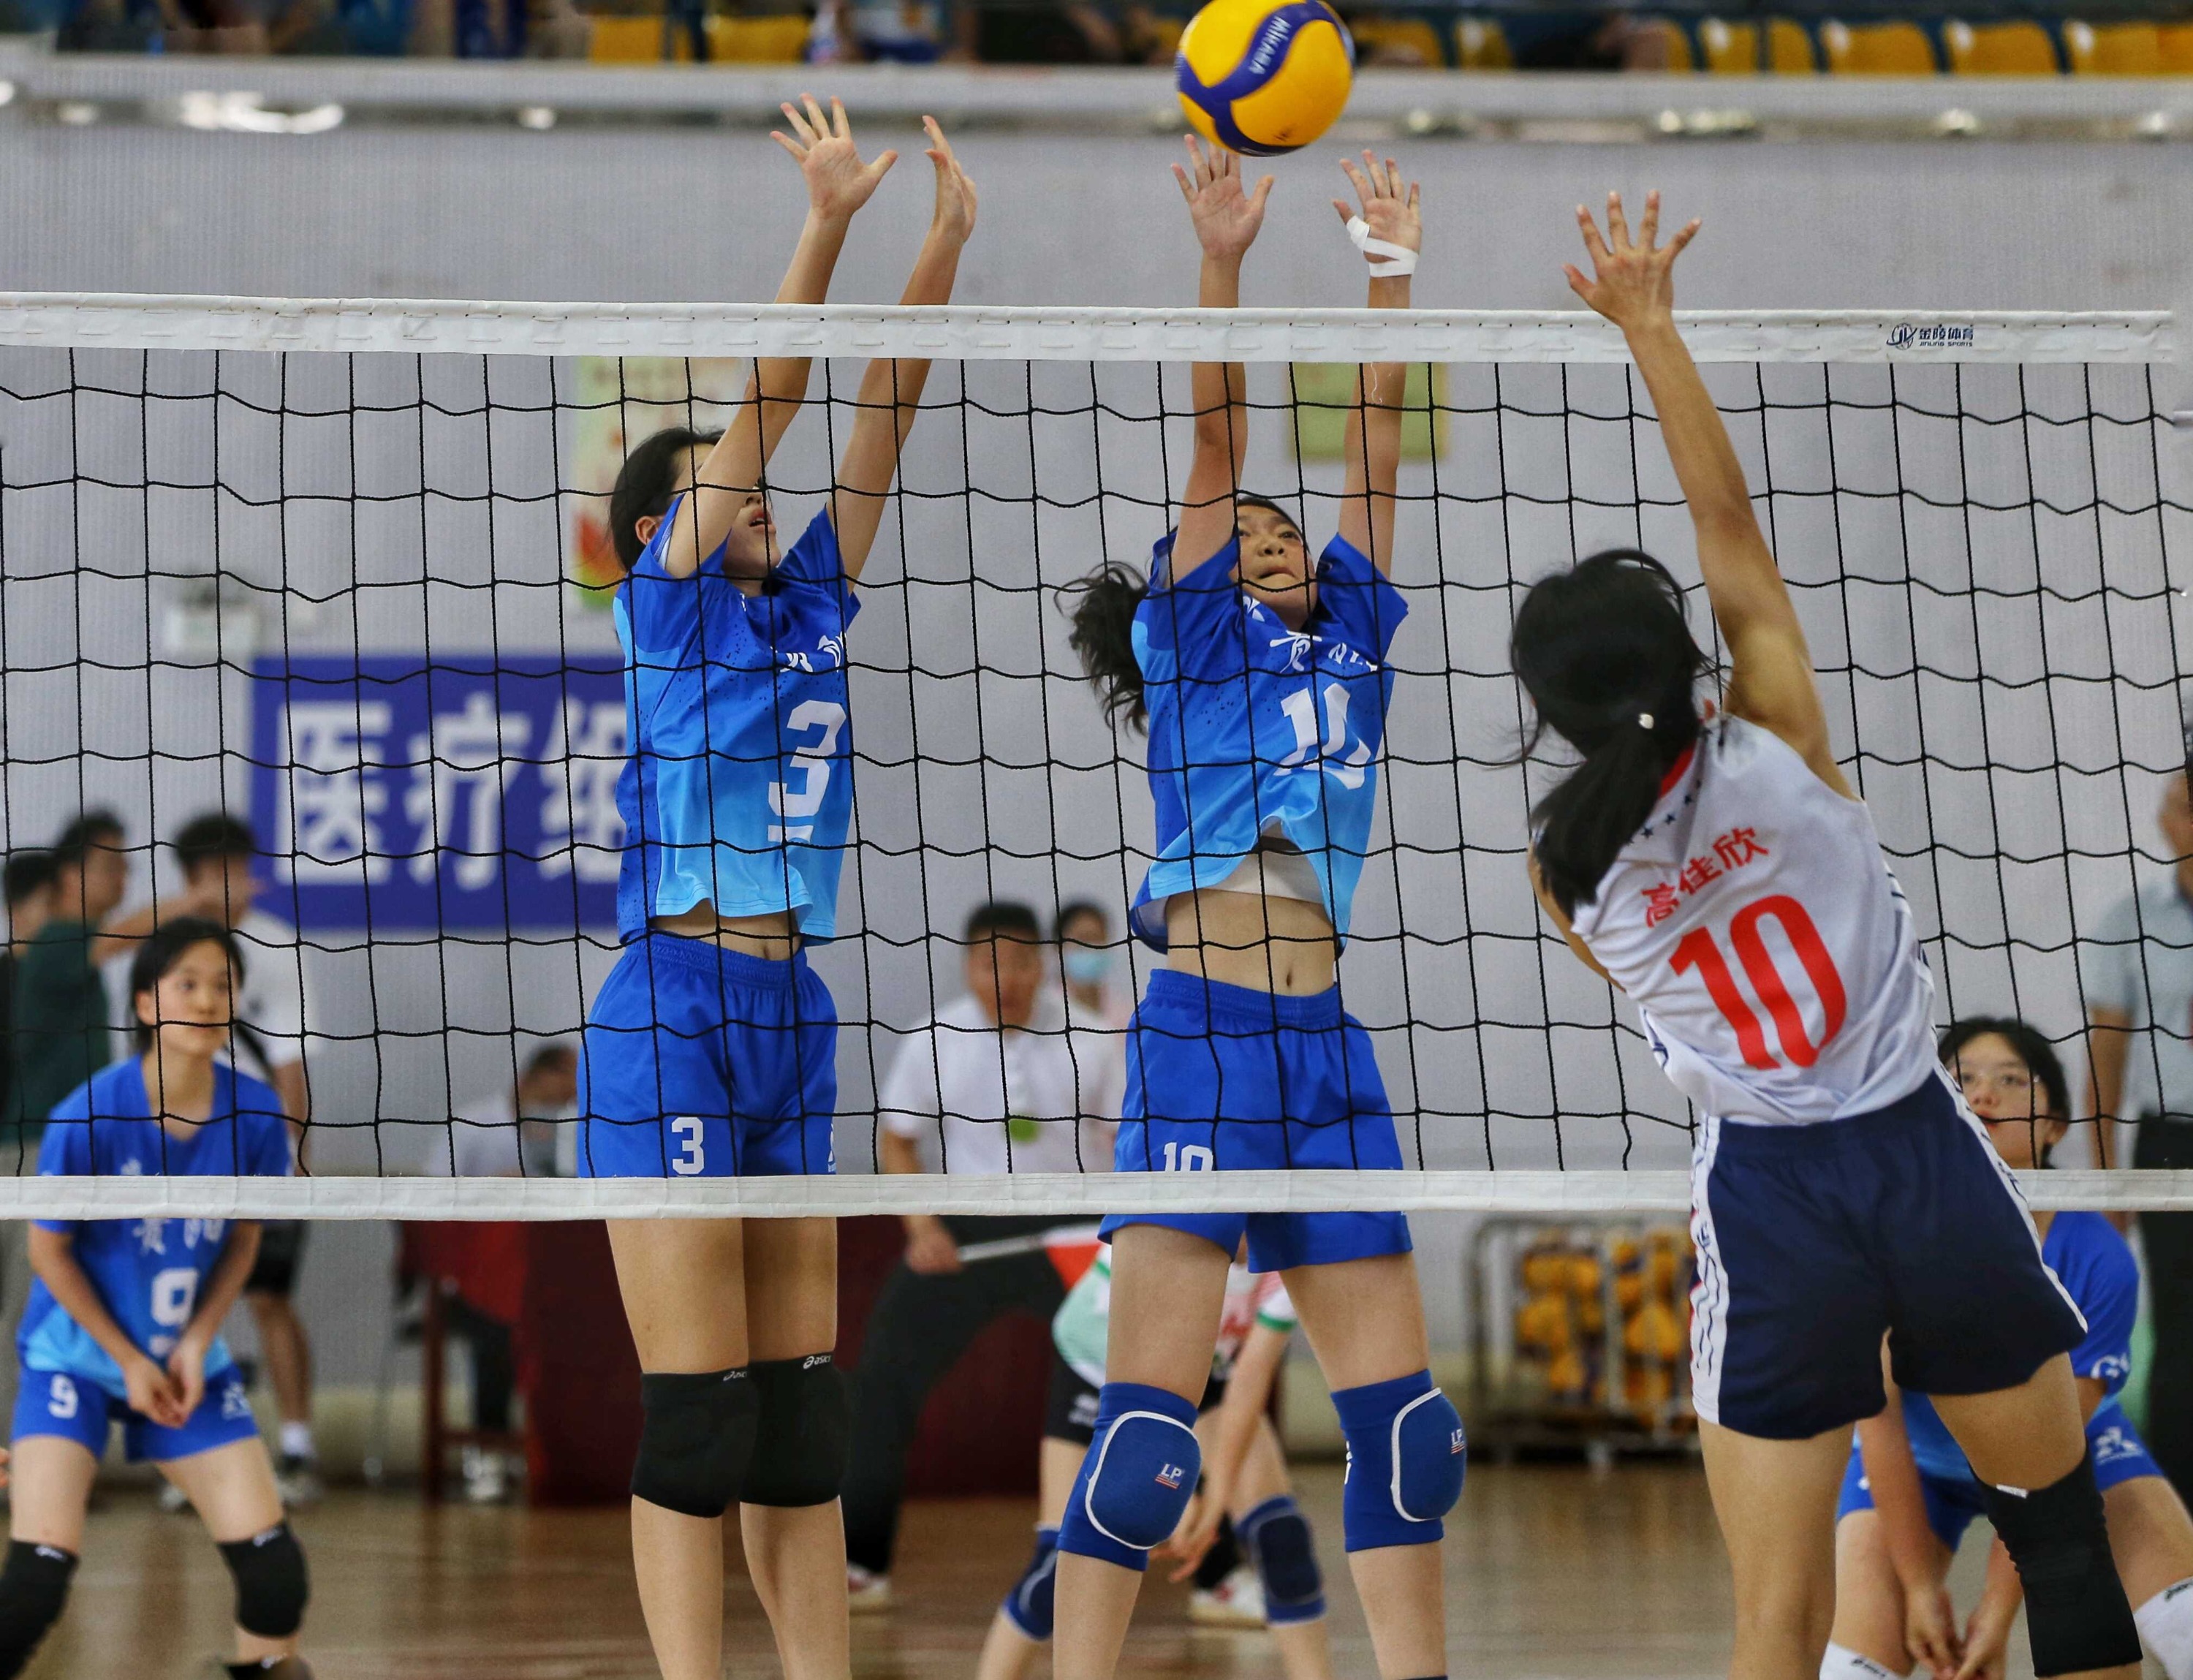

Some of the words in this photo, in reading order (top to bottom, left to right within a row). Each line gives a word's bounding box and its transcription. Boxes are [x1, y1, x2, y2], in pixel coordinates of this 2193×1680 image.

[1249, 15, 1292, 75] MIKASA
[768, 700, 846, 817] 3
[1641, 827, 1769, 928] 高佳欣
[1669, 895, 1847, 1070] 10
[671, 1117, 705, 1174] 3
[48, 1374, 79, 1419] 9
[1161, 1464, 1182, 1479] LP
